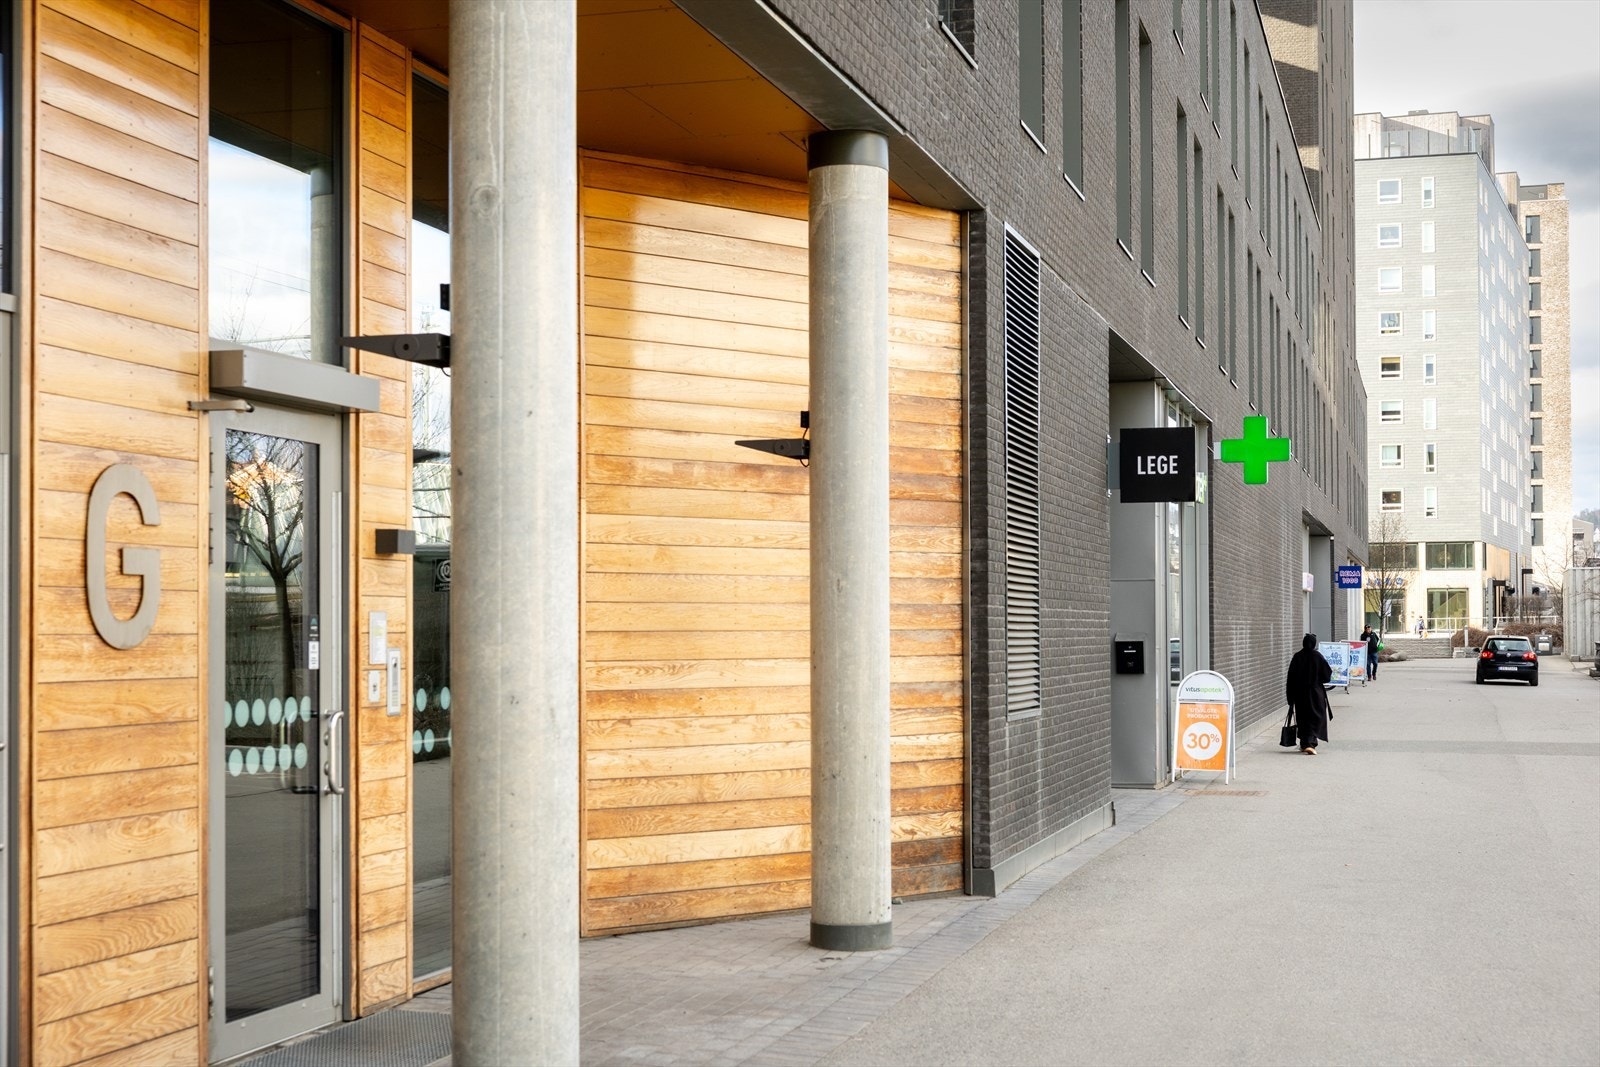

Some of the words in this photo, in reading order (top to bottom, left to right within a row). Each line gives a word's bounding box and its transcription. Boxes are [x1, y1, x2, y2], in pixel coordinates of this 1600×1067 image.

[1137, 455, 1179, 475] LEGE
[85, 463, 161, 650] G
[1187, 732, 1220, 750] 30%
